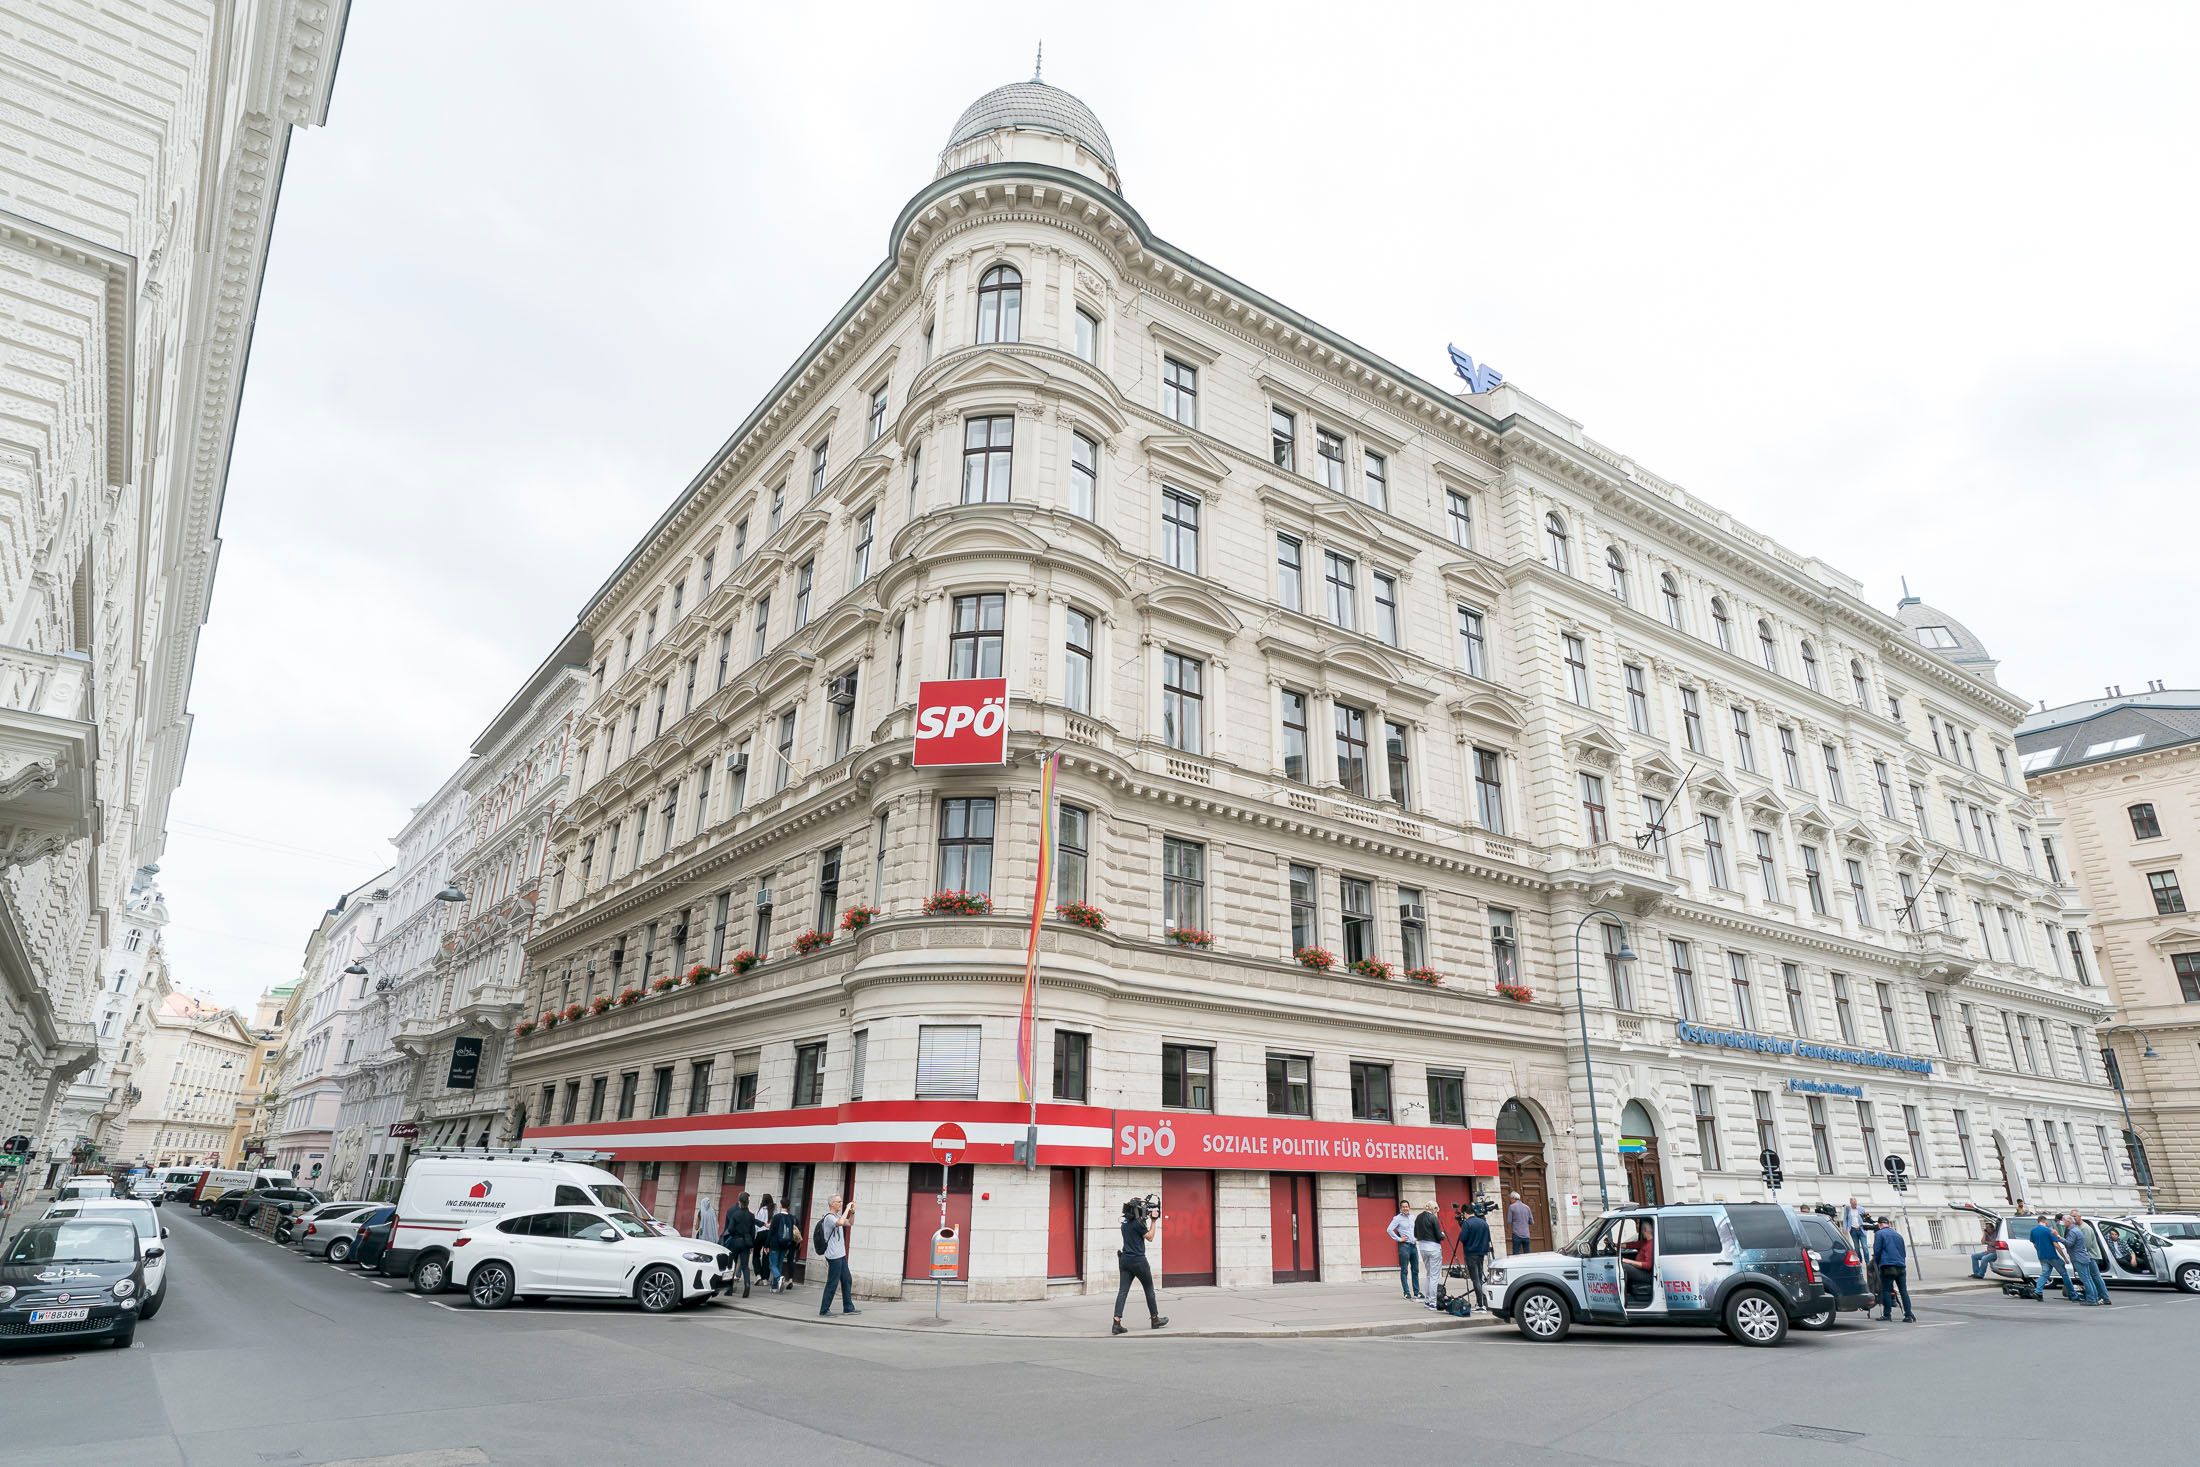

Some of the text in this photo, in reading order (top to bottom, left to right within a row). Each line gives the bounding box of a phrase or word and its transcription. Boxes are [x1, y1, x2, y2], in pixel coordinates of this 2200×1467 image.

[916, 697, 1005, 739] SPÖ
[1120, 1119, 1176, 1157] SPÖ
[1202, 1134, 1449, 1161] SOZIALE POLITIK FÜR ÖSTERREICH.
[1664, 1280, 1692, 1293] TEN
